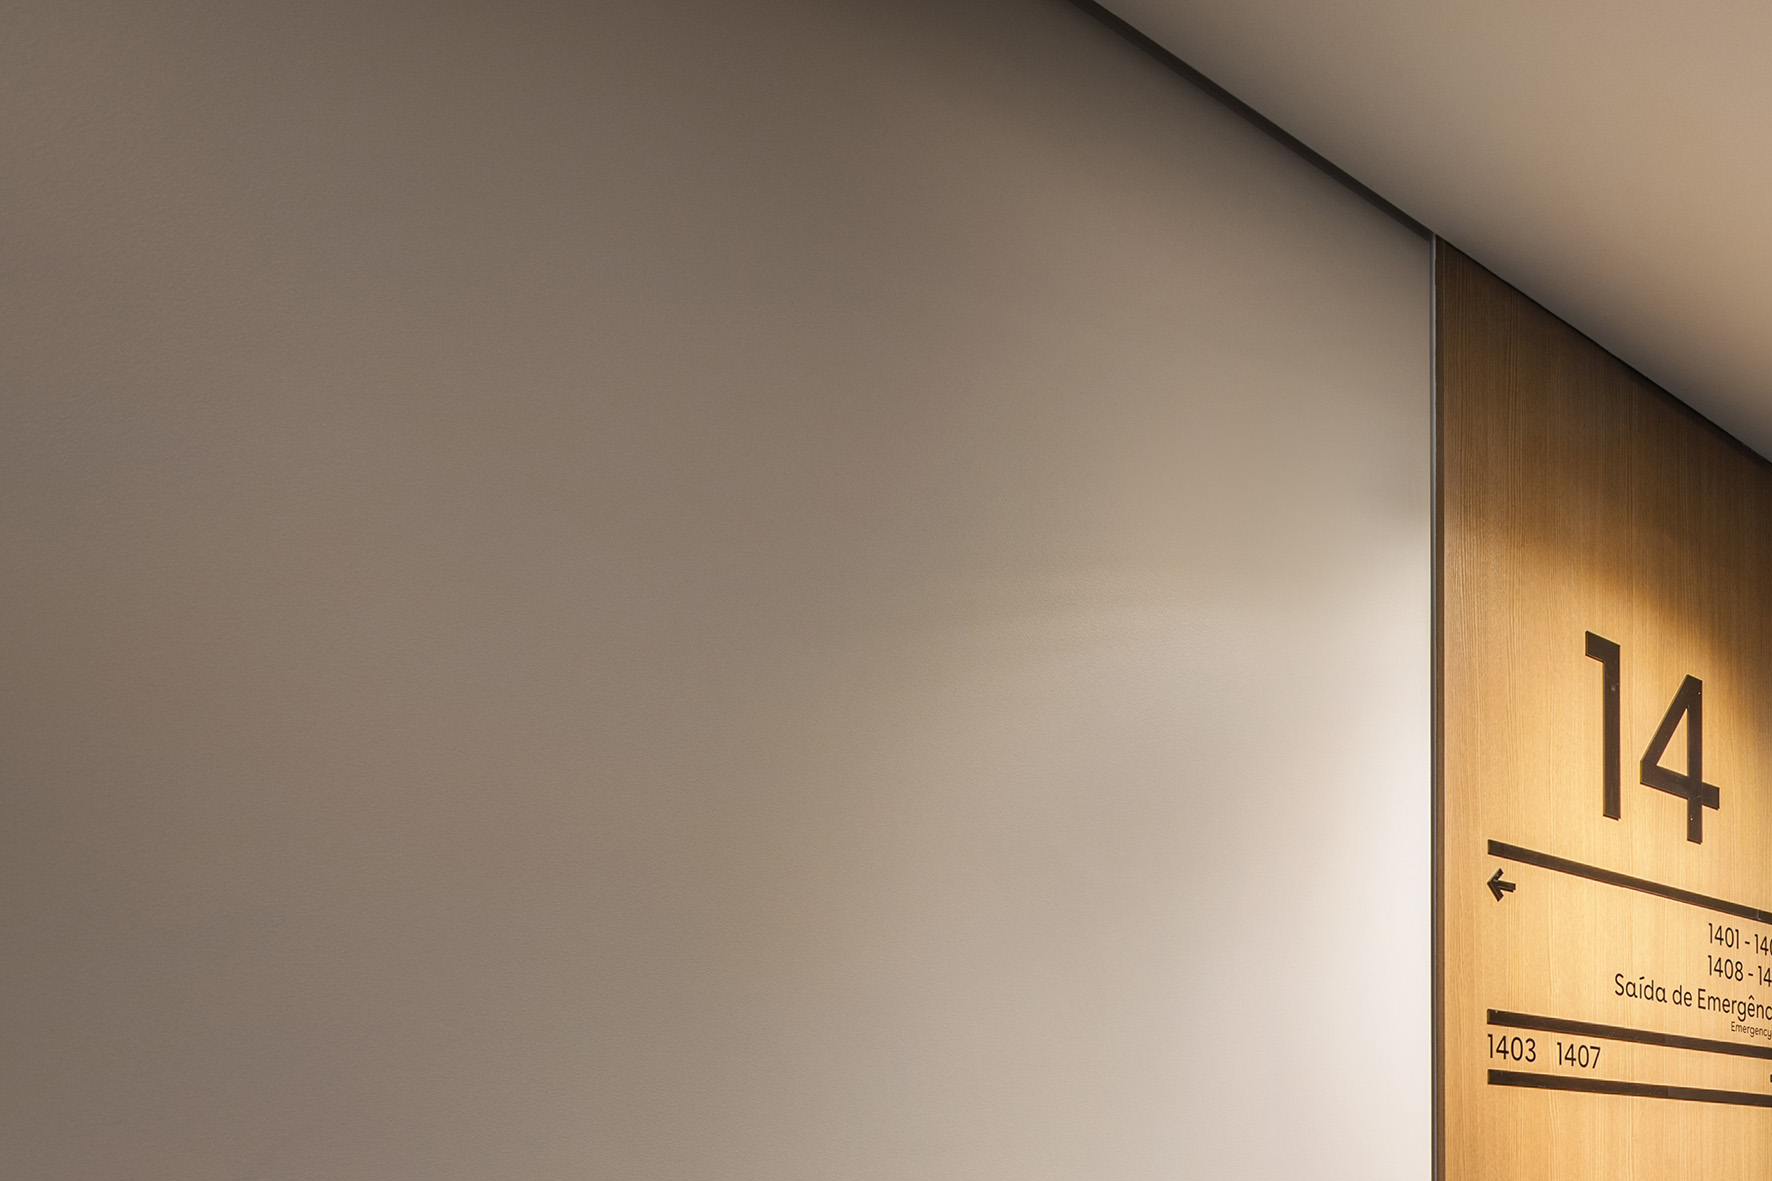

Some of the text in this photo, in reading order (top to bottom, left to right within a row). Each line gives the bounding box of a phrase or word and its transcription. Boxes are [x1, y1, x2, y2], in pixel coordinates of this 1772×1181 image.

[1584, 630, 1720, 845] 14
[1708, 922, 1740, 950] 1401
[1707, 954, 1744, 982] 1408
[1614, 973, 1668, 1004] Saída
[1672, 984, 1693, 1007] de
[1730, 1020, 1772, 1041] Emergency
[1487, 1033, 1601, 1069] 1403 1407
